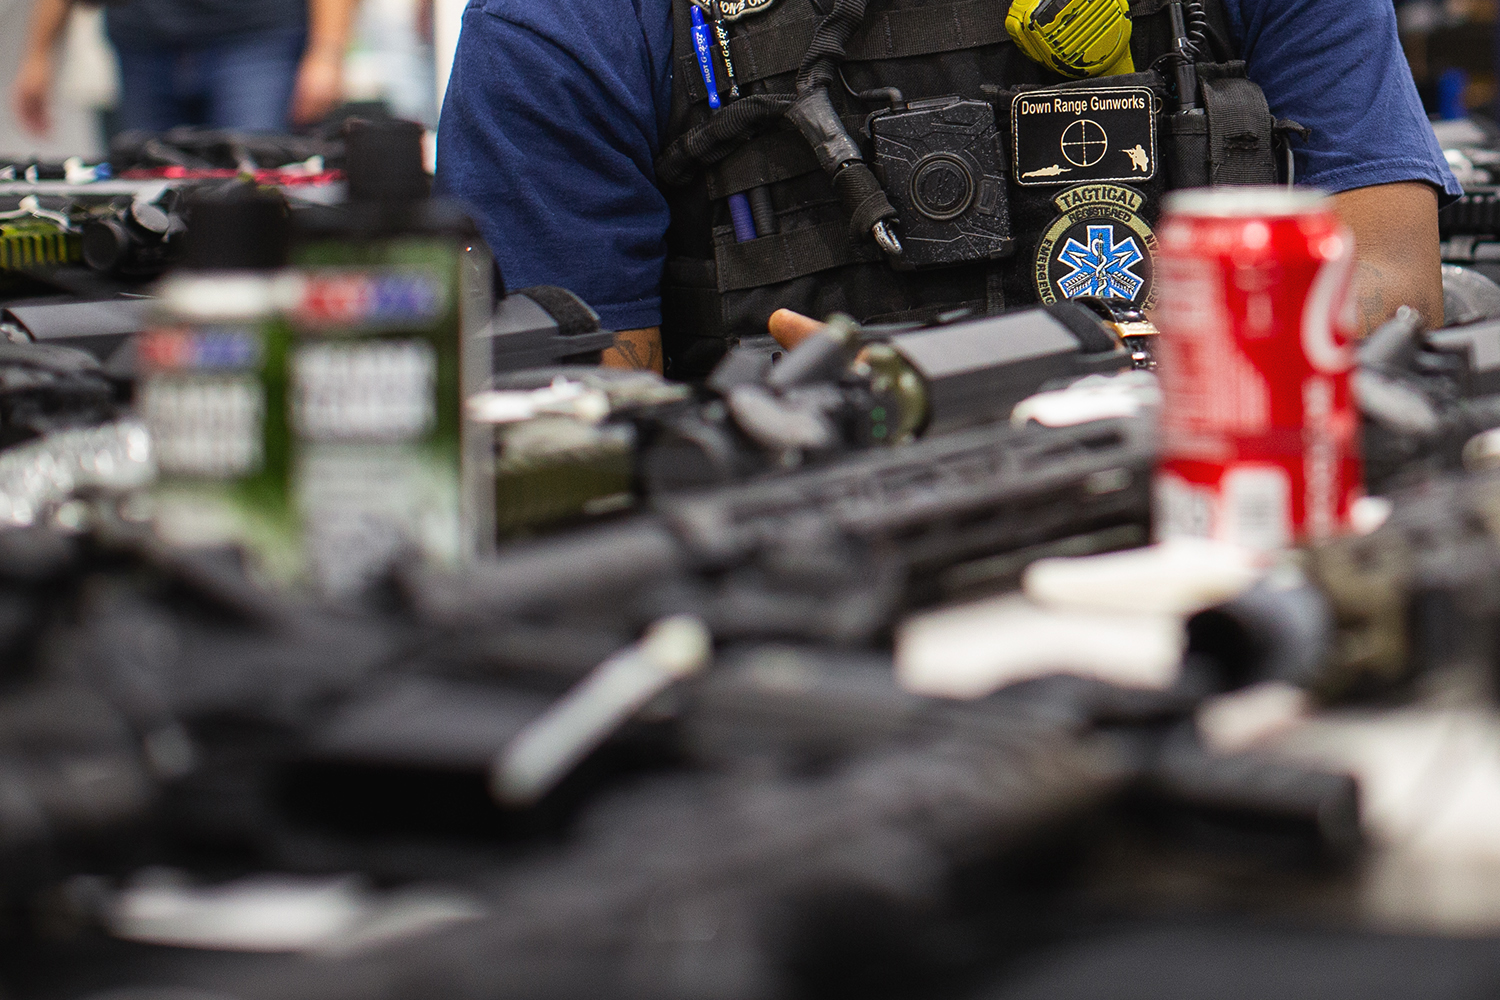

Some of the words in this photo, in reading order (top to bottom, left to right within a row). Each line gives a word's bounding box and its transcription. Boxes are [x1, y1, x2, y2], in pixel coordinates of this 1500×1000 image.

[703, 64, 712, 83] PILOT
[724, 58, 735, 78] PILOT
[1021, 100, 1051, 115] Down
[1054, 98, 1088, 116] Range
[1090, 94, 1145, 111] Gunworks
[1059, 186, 1136, 209] TACTICAL
[1068, 206, 1132, 224] REGISTERED
[1036, 238, 1057, 306] EMERGENC
